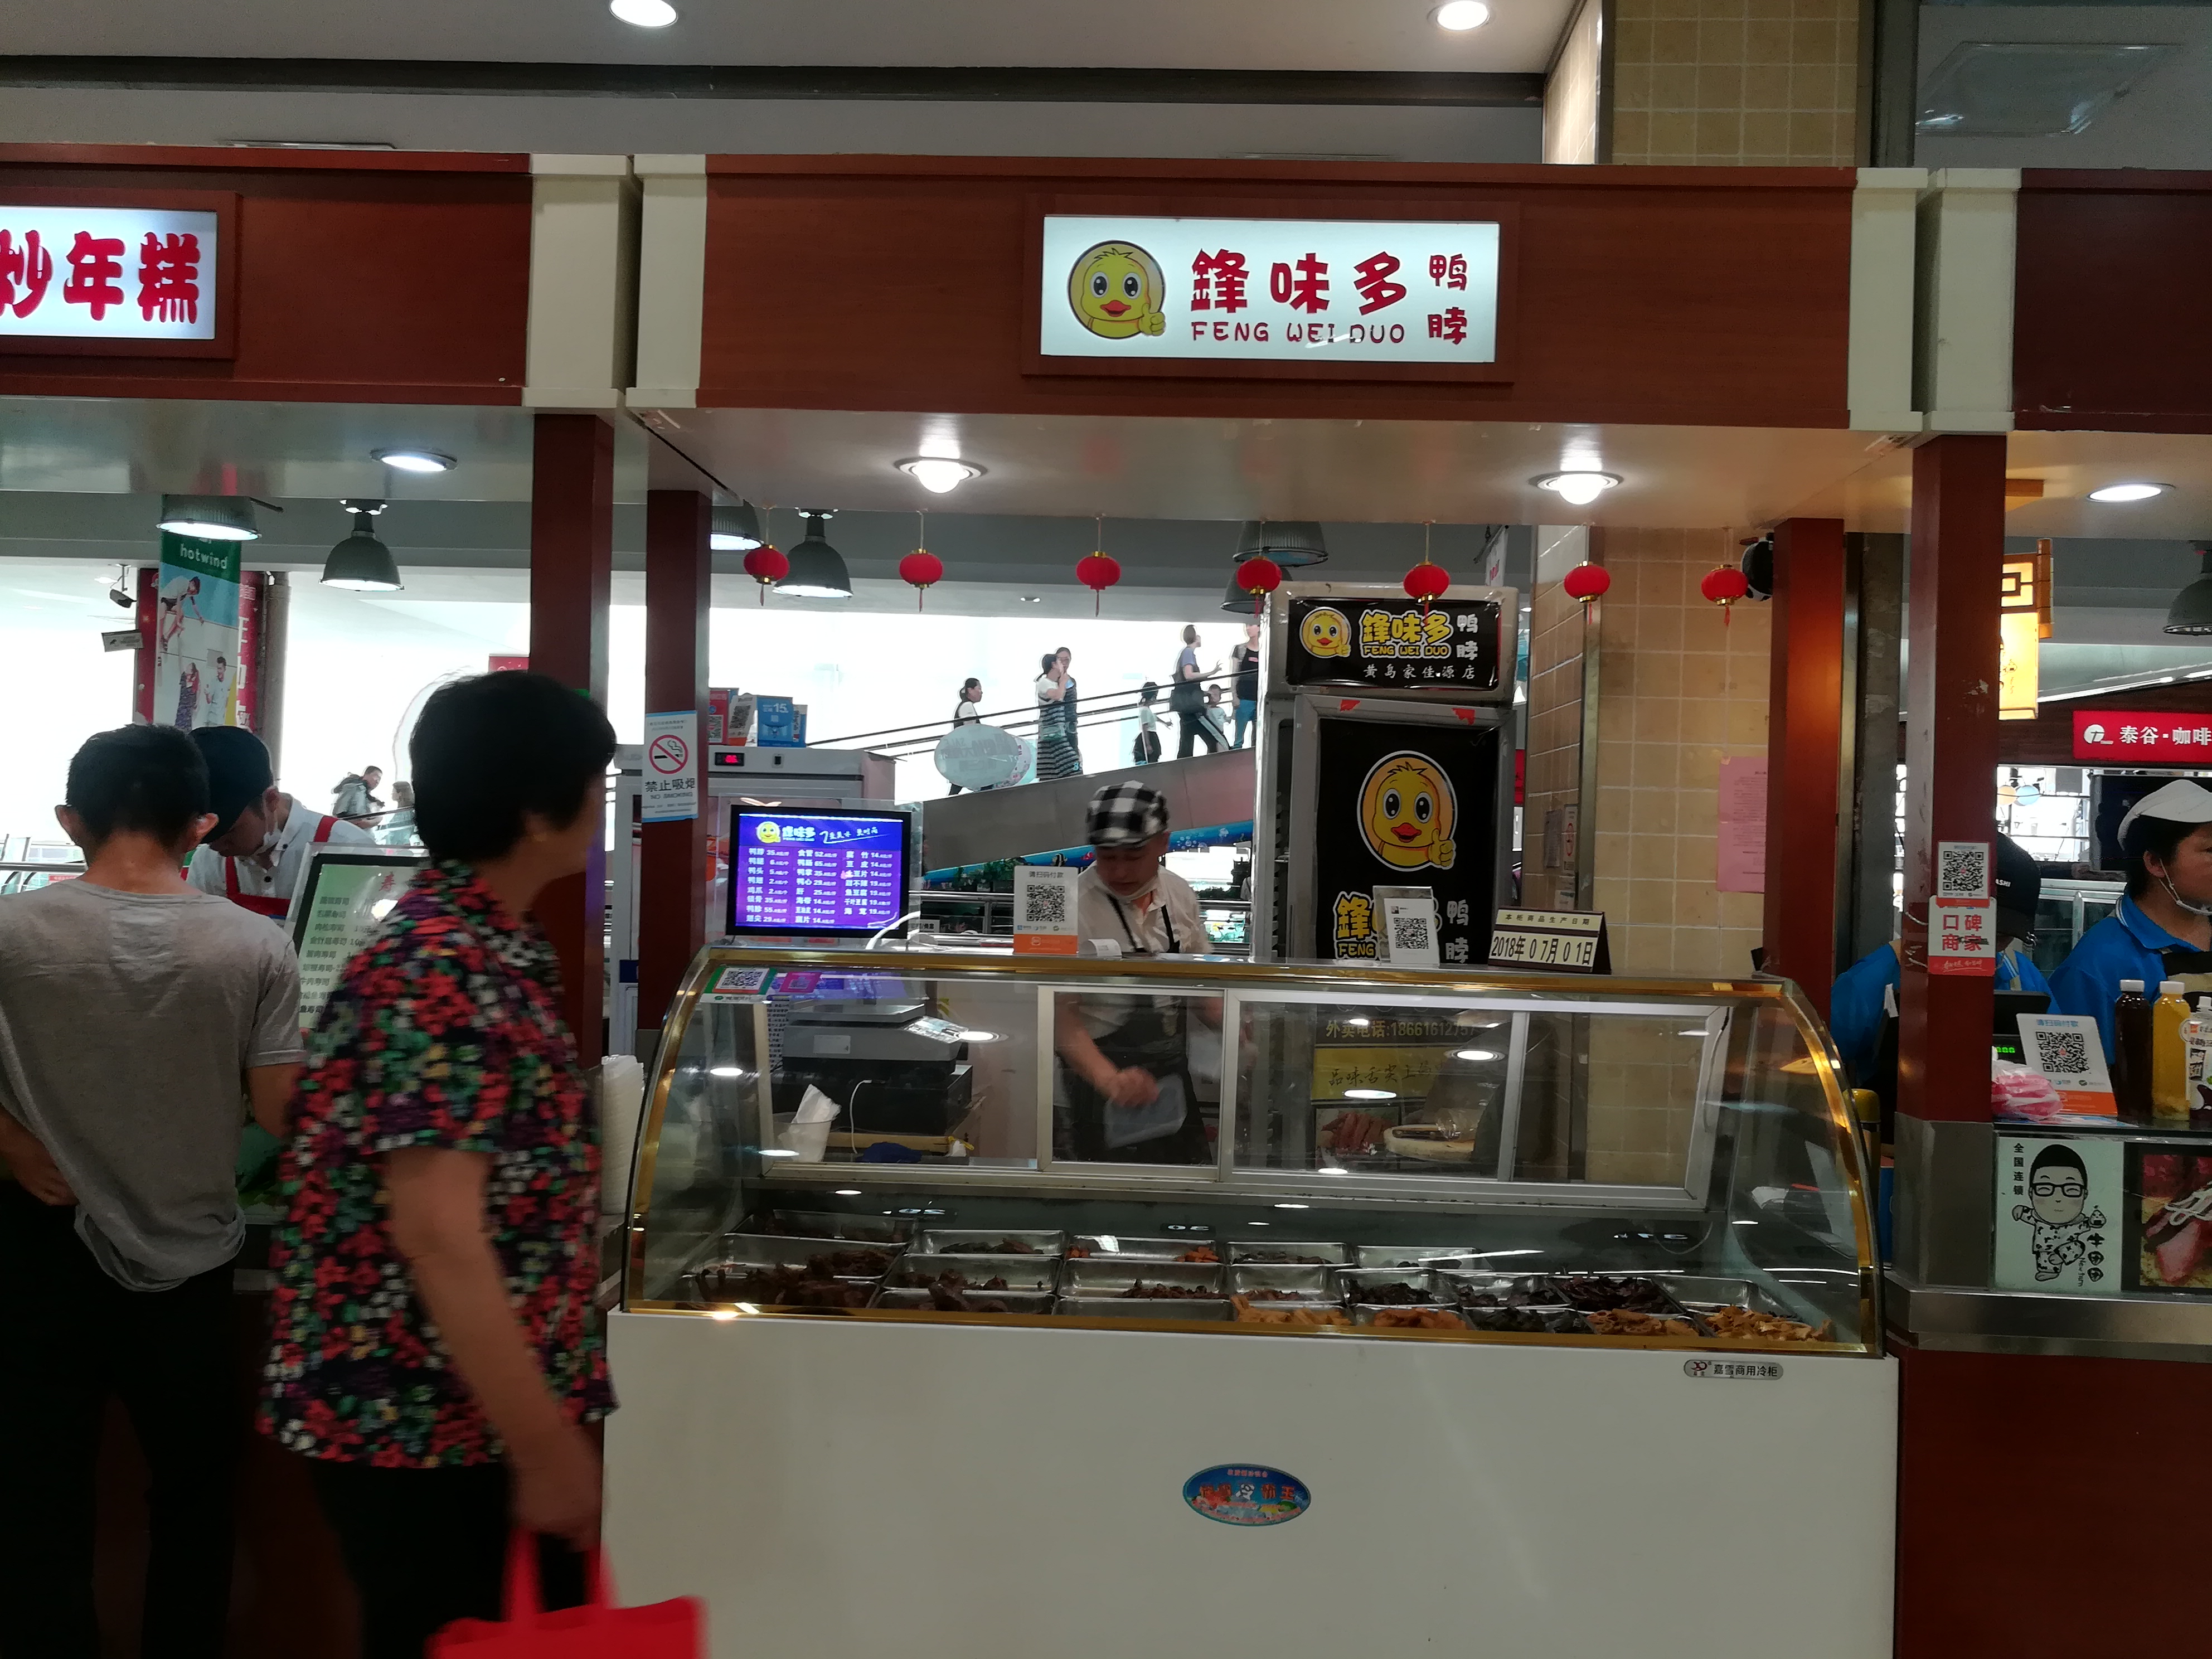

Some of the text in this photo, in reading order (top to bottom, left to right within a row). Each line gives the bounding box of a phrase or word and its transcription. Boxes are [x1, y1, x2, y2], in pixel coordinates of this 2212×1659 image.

[0, 229, 201, 324] 炒年糕
[1190, 248, 1408, 316] 鋒味多
[1427, 254, 1468, 346] 鸭脖
[1191, 322, 1406, 345] FENG WEI DUO
[180, 544, 228, 570] hotwind
[1362, 612, 1451, 645] 鋒味多
[1456, 613, 1478, 661] 鸭脖
[1364, 646, 1448, 655] FENG WEI DUO
[1364, 663, 1476, 678] 黄岛家佳源店
[645, 778, 695, 792] 禁止吸烟
[1942, 914, 1982, 932] 口碑
[1338, 943, 1375, 956] FENG
[1942, 934, 1982, 952] 商家
[2013, 1143, 2024, 1196] 全国连锁
[1714, 1364, 1778, 1377] 嘉雪商用冷柜
